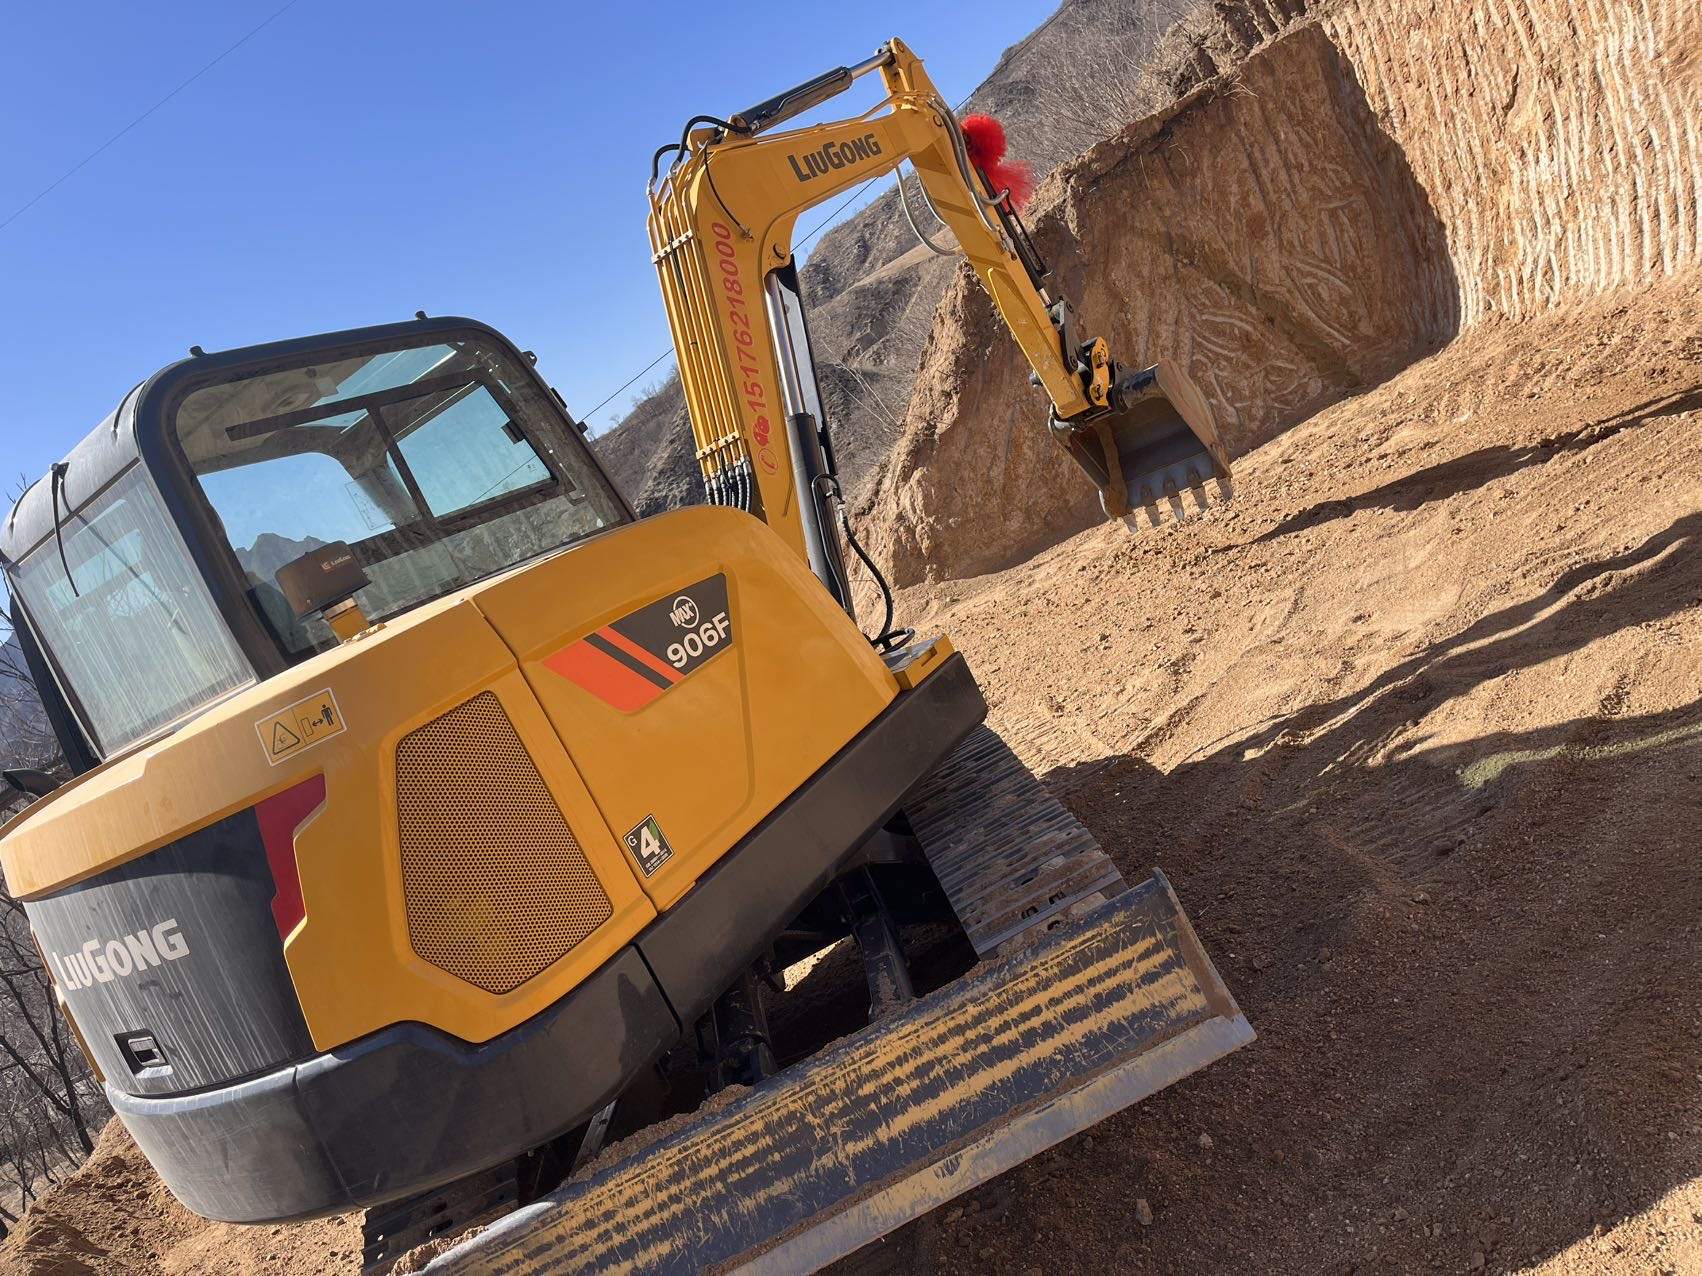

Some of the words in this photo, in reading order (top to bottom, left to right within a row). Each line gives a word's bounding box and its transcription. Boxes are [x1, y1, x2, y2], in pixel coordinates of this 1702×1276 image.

[711, 222, 767, 413] 15176218000
[666, 611, 729, 668] 906F
[627, 835, 638, 847] G
[640, 825, 661, 859] 4
